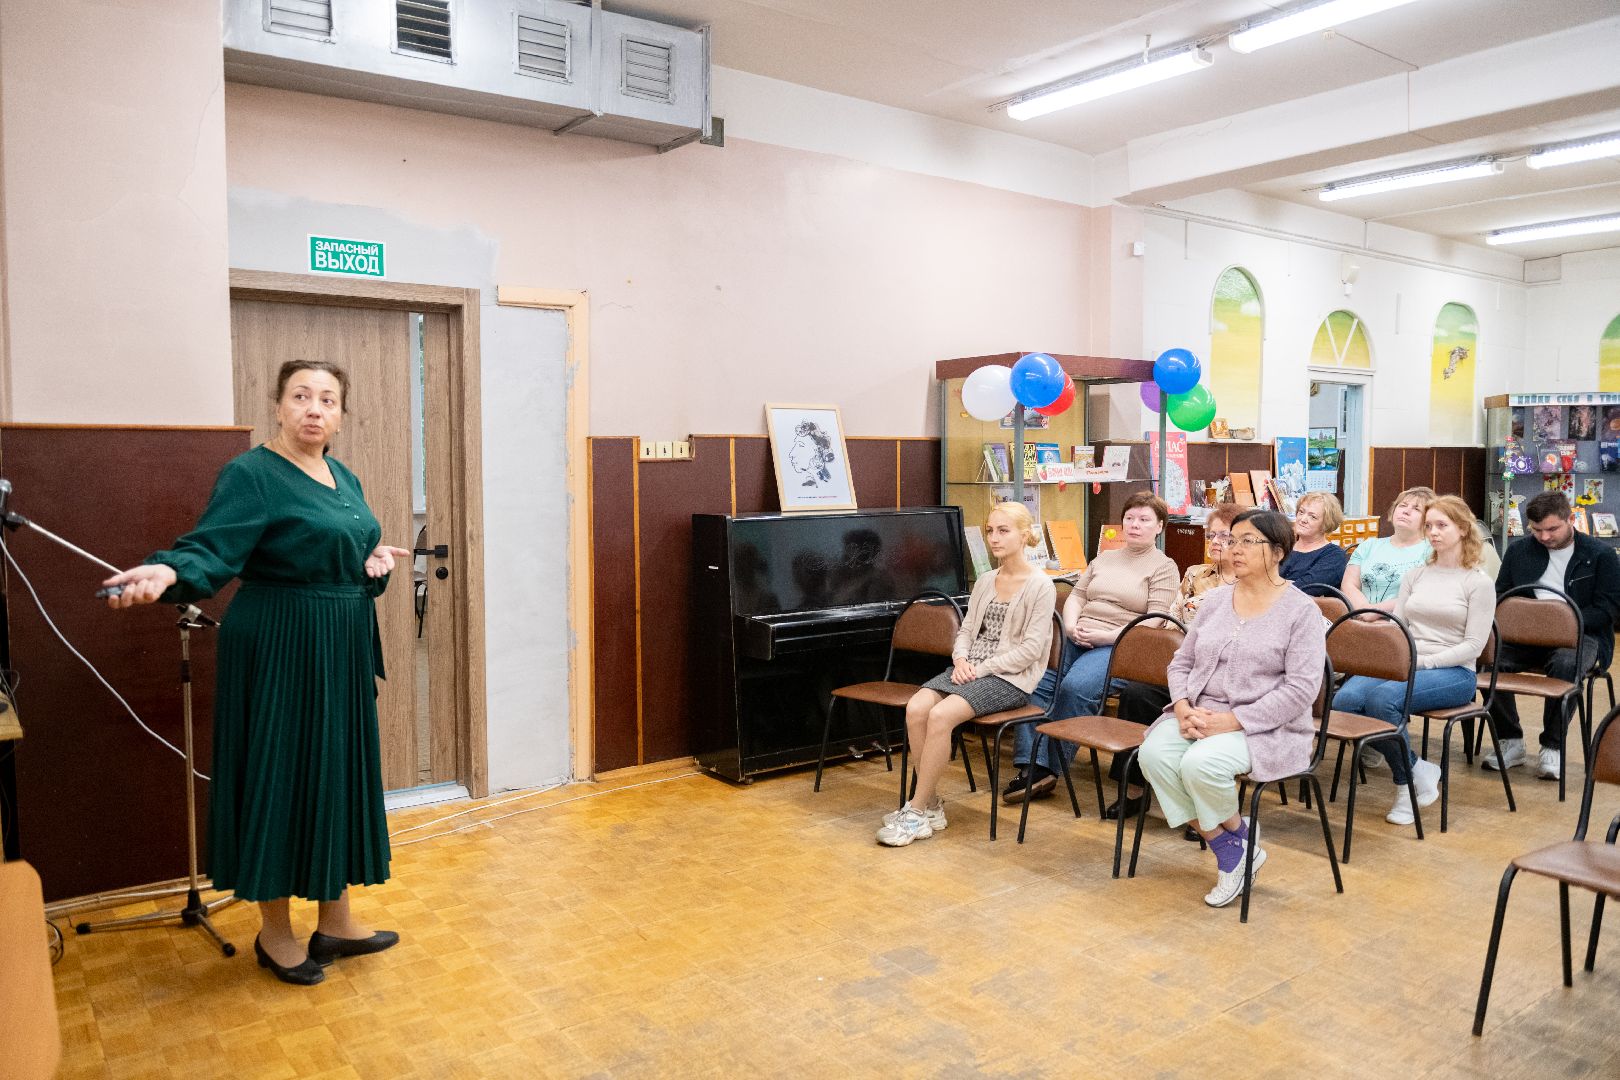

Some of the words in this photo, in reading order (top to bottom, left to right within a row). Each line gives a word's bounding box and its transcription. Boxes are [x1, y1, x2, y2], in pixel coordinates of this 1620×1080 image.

[315, 241, 379, 255] ЗАПАСНЫЙ
[315, 251, 380, 274] ВЫХОД
[1153, 440, 1184, 453] АЛАС
